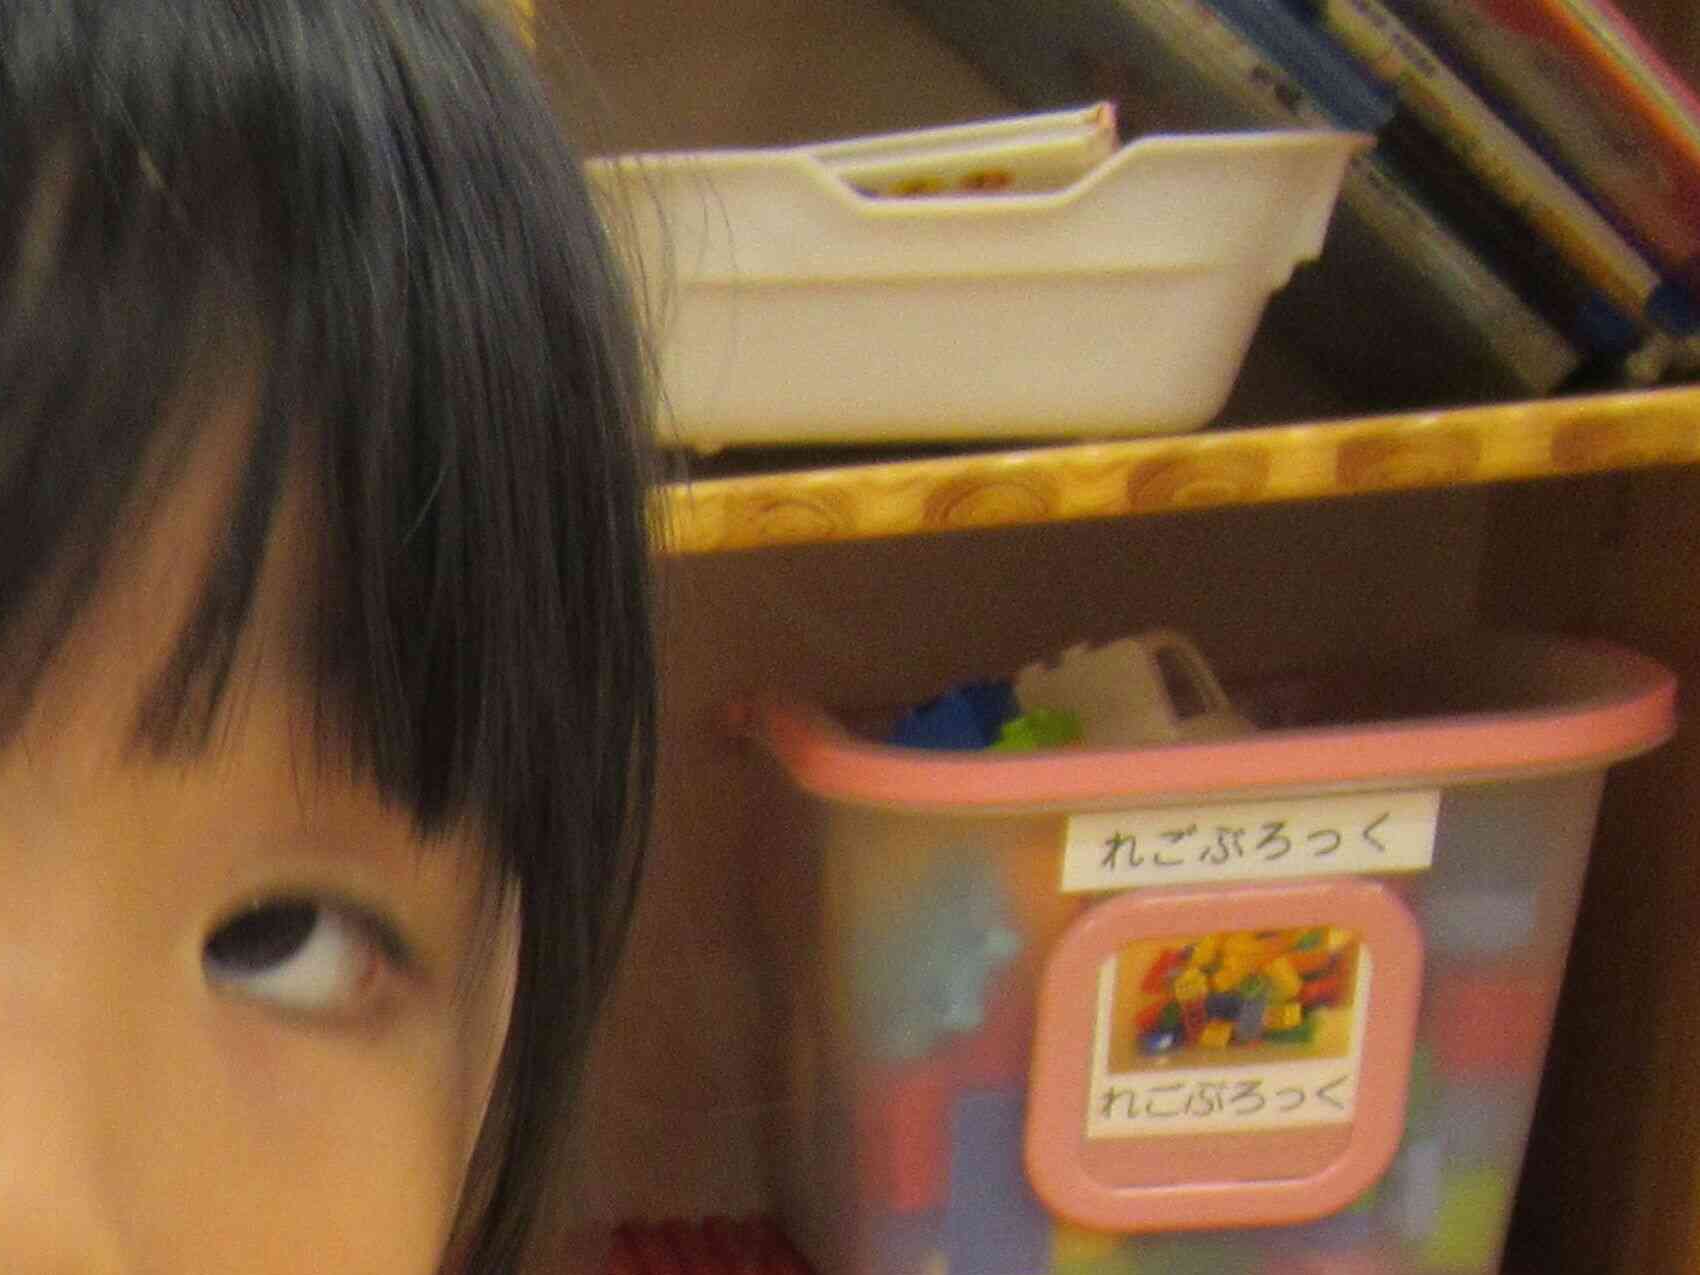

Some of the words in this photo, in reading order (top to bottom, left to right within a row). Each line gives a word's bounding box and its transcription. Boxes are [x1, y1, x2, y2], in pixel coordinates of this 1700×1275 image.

[1101, 811, 1392, 869] れごぶろっく
[1101, 1078, 1353, 1119] れごぶろっく
